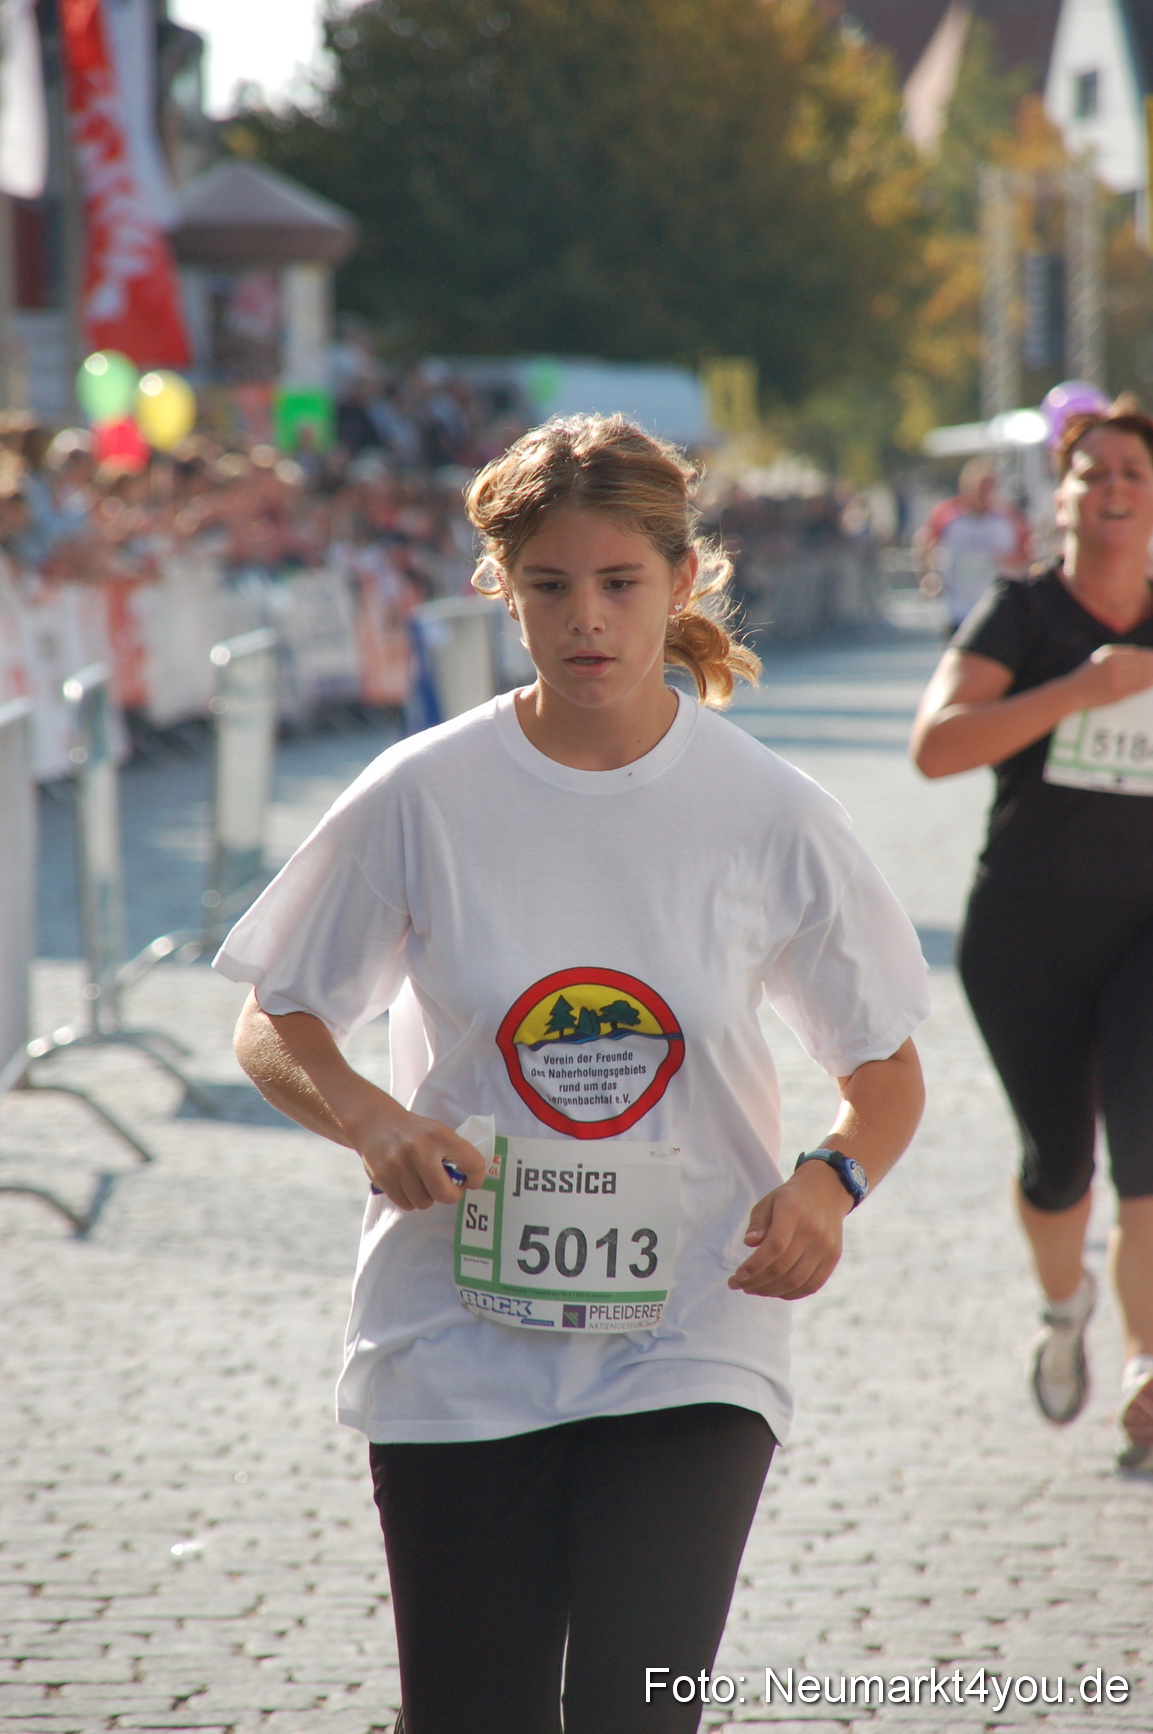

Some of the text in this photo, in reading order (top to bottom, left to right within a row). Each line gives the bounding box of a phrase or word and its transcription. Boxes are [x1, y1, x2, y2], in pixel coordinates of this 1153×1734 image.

[543, 1050, 633, 1065] Verein der Freunde
[548, 1064, 647, 1079] Naherholungsgebiets
[559, 1080, 617, 1092] rund um das
[615, 1093, 631, 1104] e.V.
[512, 1159, 617, 1198] jessica
[465, 1203, 488, 1232] Sc
[516, 1224, 659, 1279] 5013
[460, 1288, 533, 1318] BOCK
